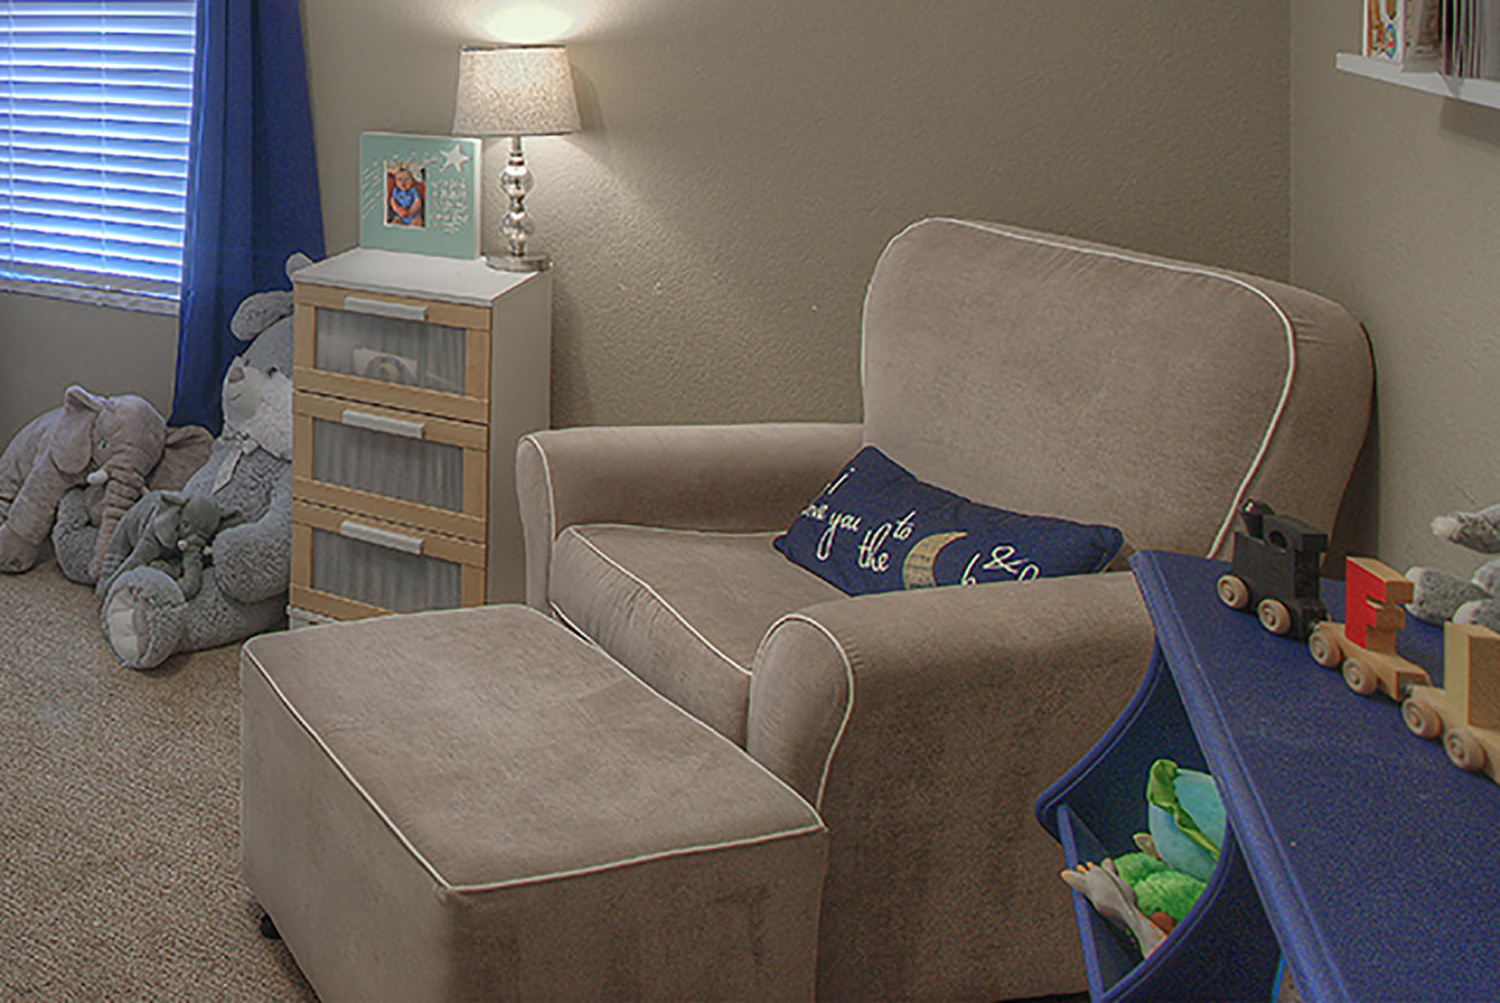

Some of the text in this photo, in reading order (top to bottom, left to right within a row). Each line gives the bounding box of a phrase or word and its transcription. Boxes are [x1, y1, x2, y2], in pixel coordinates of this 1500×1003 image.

[816, 512, 862, 561] you
[857, 523, 892, 572] the
[892, 510, 916, 541] to
